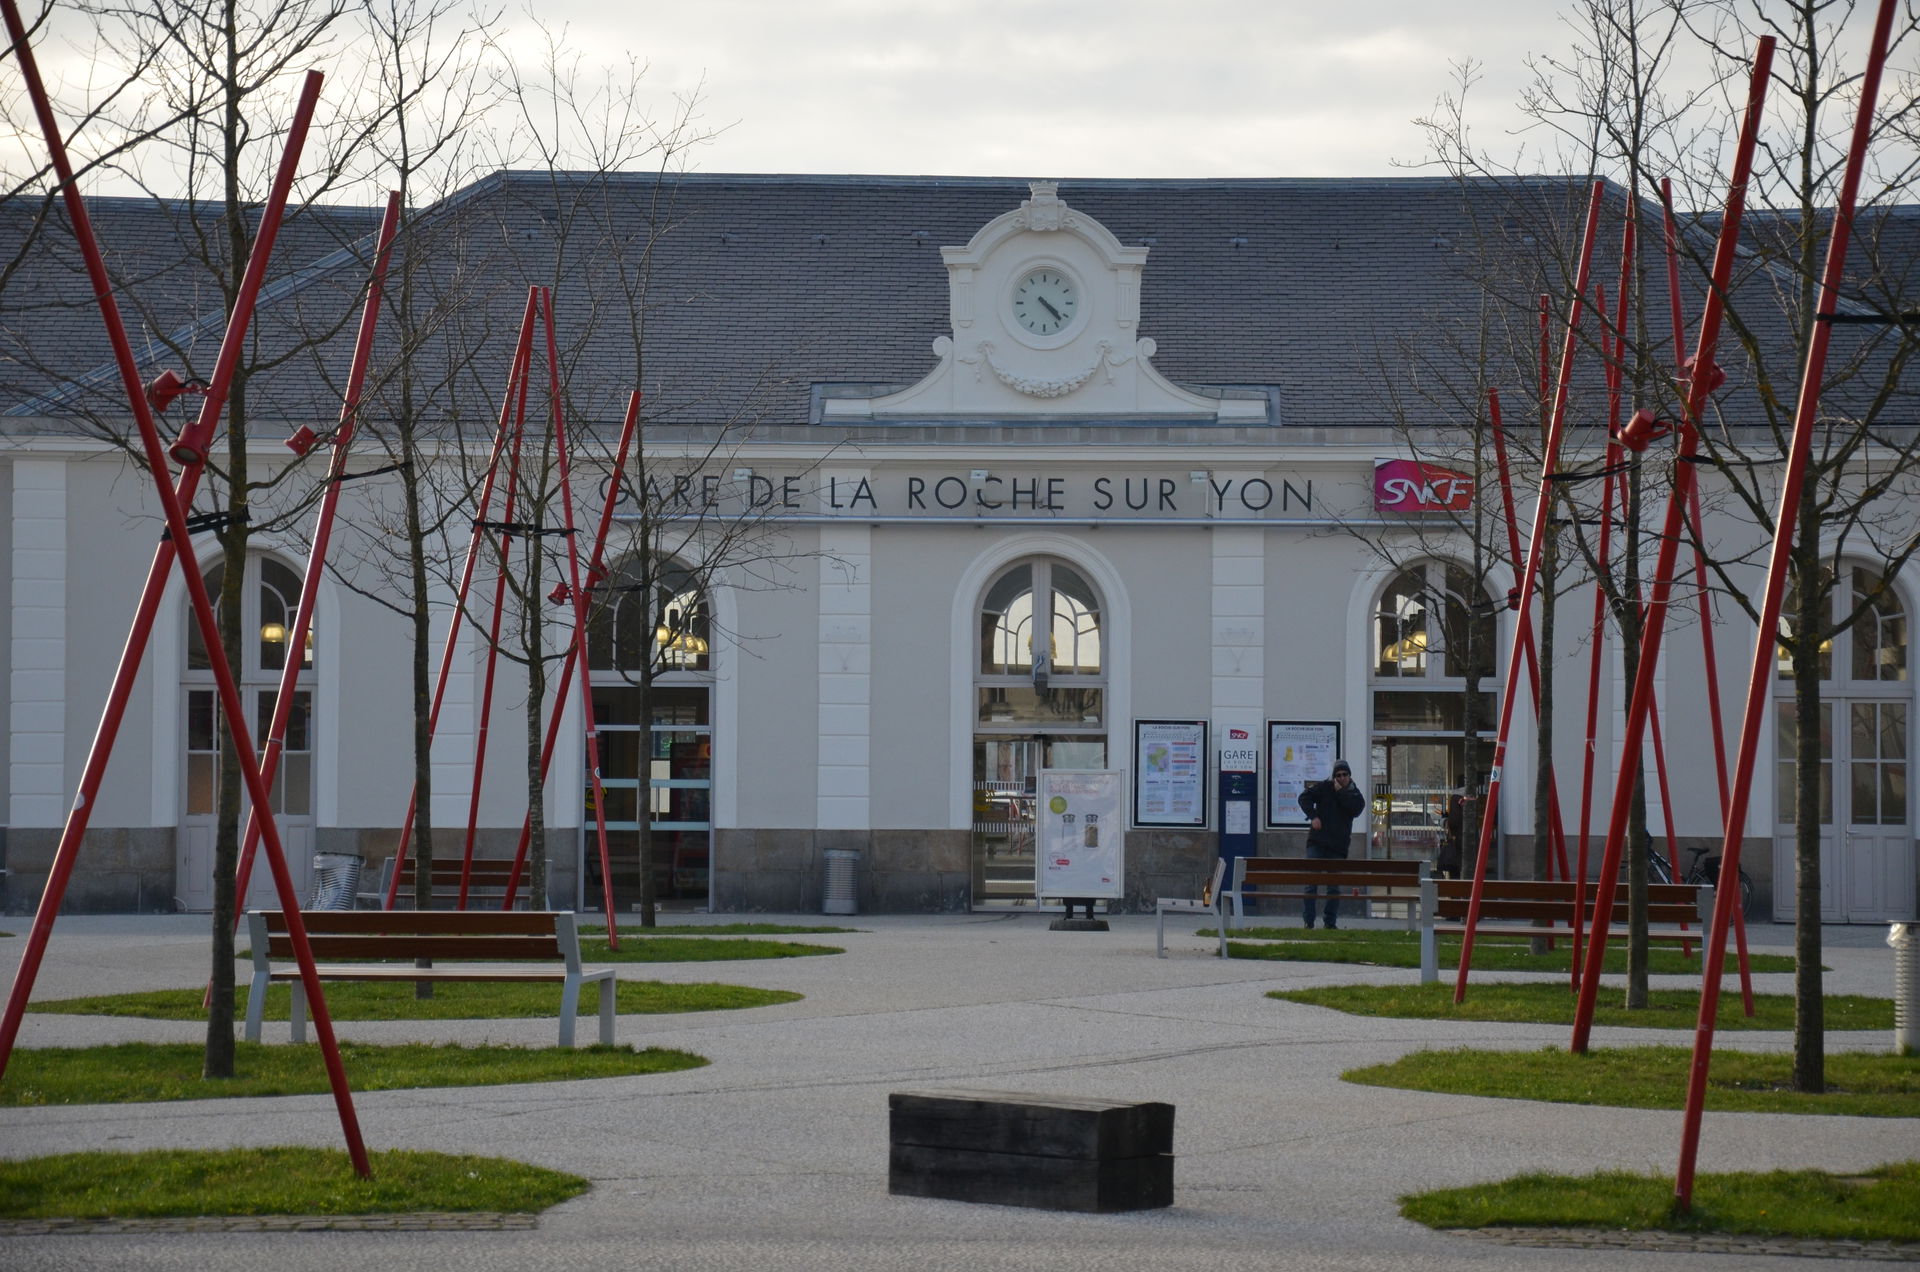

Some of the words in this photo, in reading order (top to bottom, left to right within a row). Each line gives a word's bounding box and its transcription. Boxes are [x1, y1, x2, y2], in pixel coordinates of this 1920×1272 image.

[599, 475, 720, 509] GARE
[749, 475, 801, 509] DE
[830, 476, 878, 510] LA
[908, 476, 1065, 511] ROCHE
[1093, 477, 1177, 512] SUR
[1211, 478, 1312, 512] YON
[1379, 478, 1473, 505] SNCF
[1223, 750, 1254, 760] GARE
